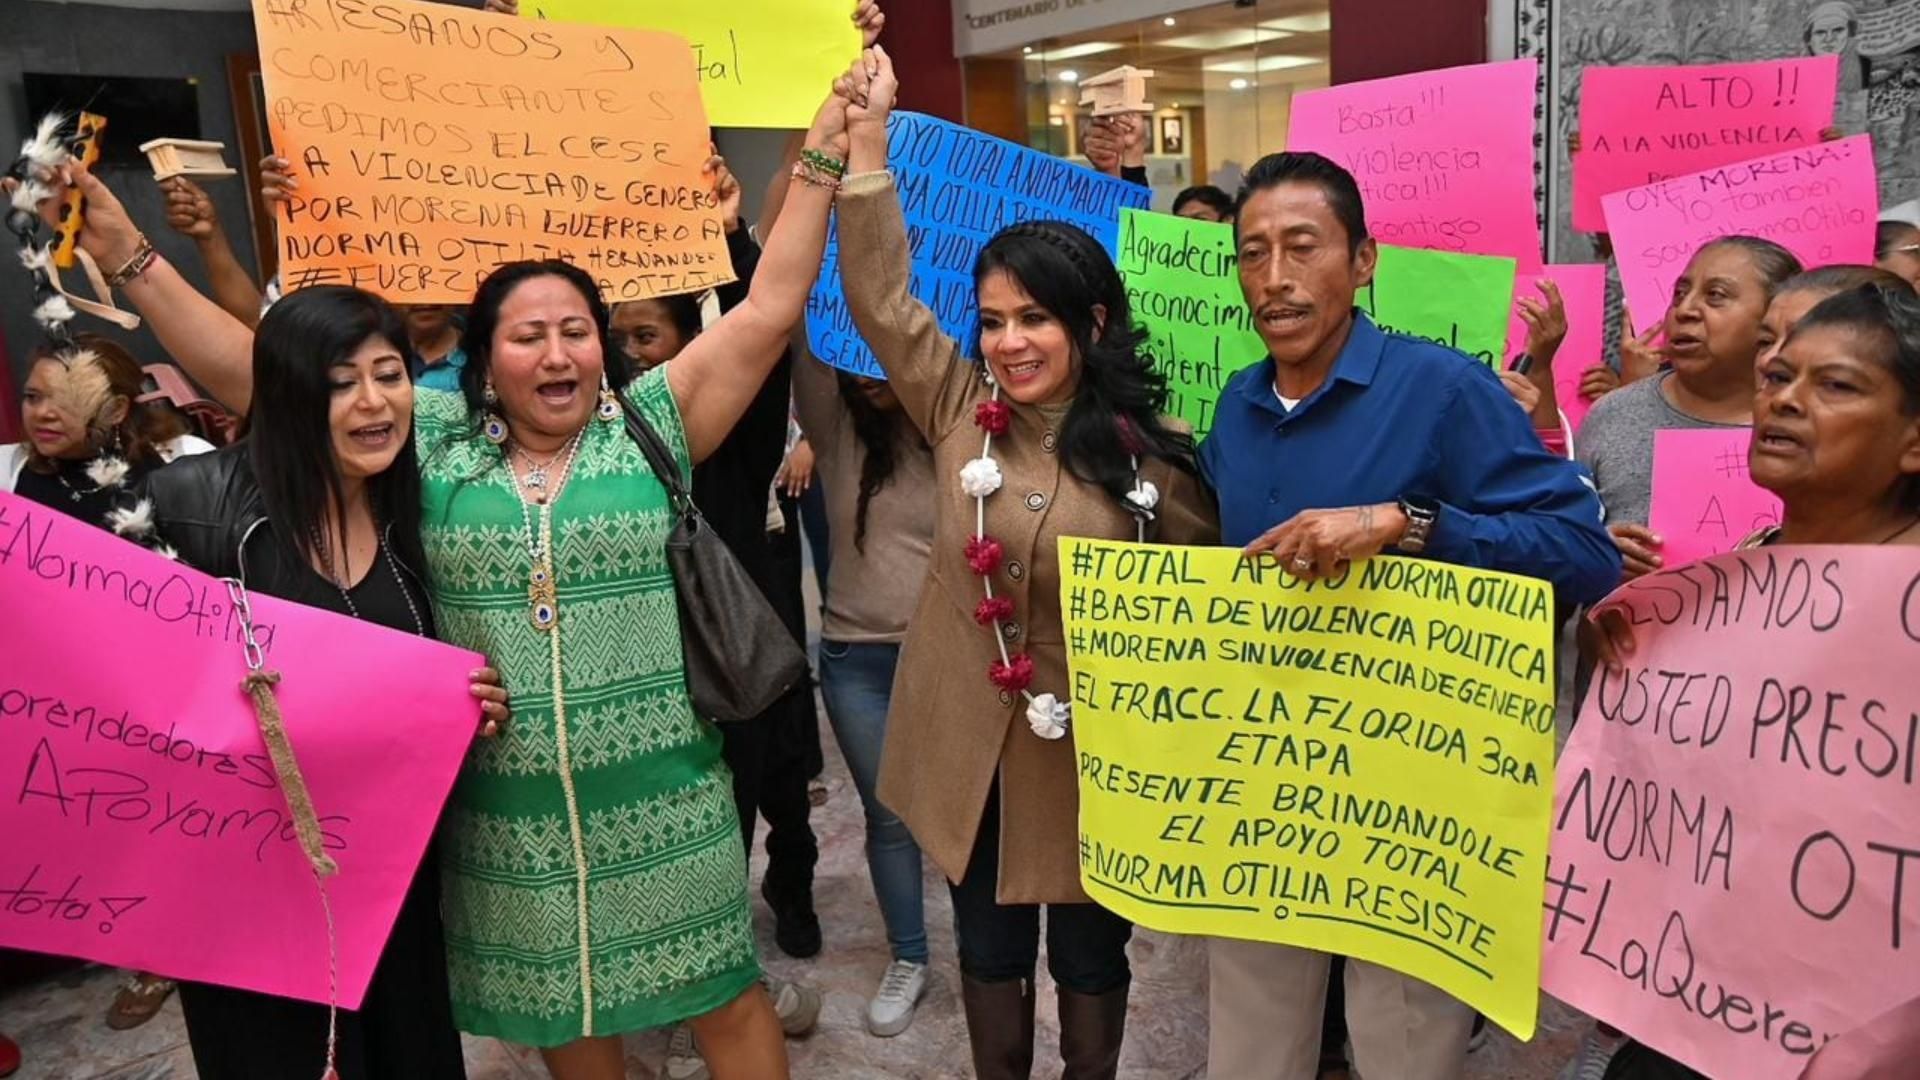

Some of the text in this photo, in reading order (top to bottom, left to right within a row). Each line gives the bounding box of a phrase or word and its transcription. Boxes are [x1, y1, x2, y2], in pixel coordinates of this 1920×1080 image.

[275, 97, 473, 153] PEDIMOS
[1655, 76, 1754, 111] ALTO
[1593, 134, 1612, 152] A
[1660, 127, 1806, 151] VIOLENCIA
[286, 195, 362, 223] POR
[372, 193, 526, 229] MORENA
[702, 218, 721, 241] A
[286, 231, 421, 261] NORMA
[1369, 214, 1482, 251] contigo
[1072, 542, 1548, 623] #TOTAL APOO NORMA OTILIA
[1070, 586, 1546, 684] #BASTA DE VIOLENCIA POLITICA
[1070, 627, 1207, 664] #MORENA
[1075, 671, 1099, 711] EL
[1111, 681, 1234, 724] FRACC.
[1243, 687, 1290, 725] LA
[1304, 695, 1468, 765] FLORIDA
[1598, 667, 1732, 749] USTED
[1216, 732, 1352, 778] ETAPA
[1080, 752, 1524, 879] PRESENTE BRINDANDOLE
[1557, 767, 1735, 892] NORMA
[1079, 833, 1498, 959] #NORMA OTILIA RESISTE
[1159, 815, 1468, 898] EL APOYO TOTAL
[1541, 854, 1842, 1056] #LaQuere
